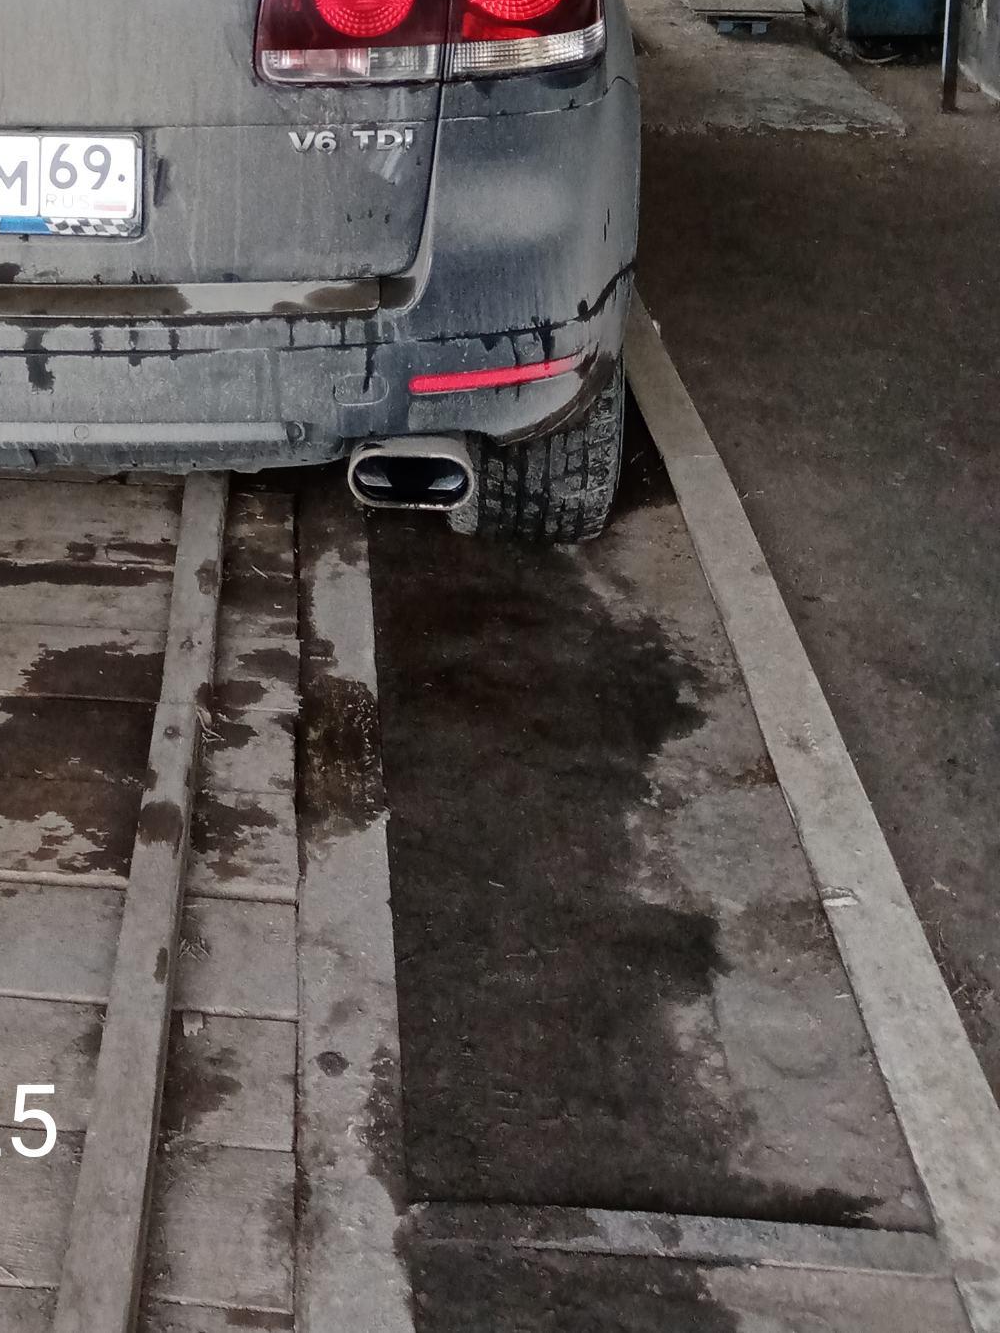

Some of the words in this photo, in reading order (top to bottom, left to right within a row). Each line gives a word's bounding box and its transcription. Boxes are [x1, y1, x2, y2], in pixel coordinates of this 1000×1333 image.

[288, 130, 337, 154] V6
[352, 128, 414, 151] TDI
[48, 143, 112, 190] 69
[45, 193, 90, 210] RUS
